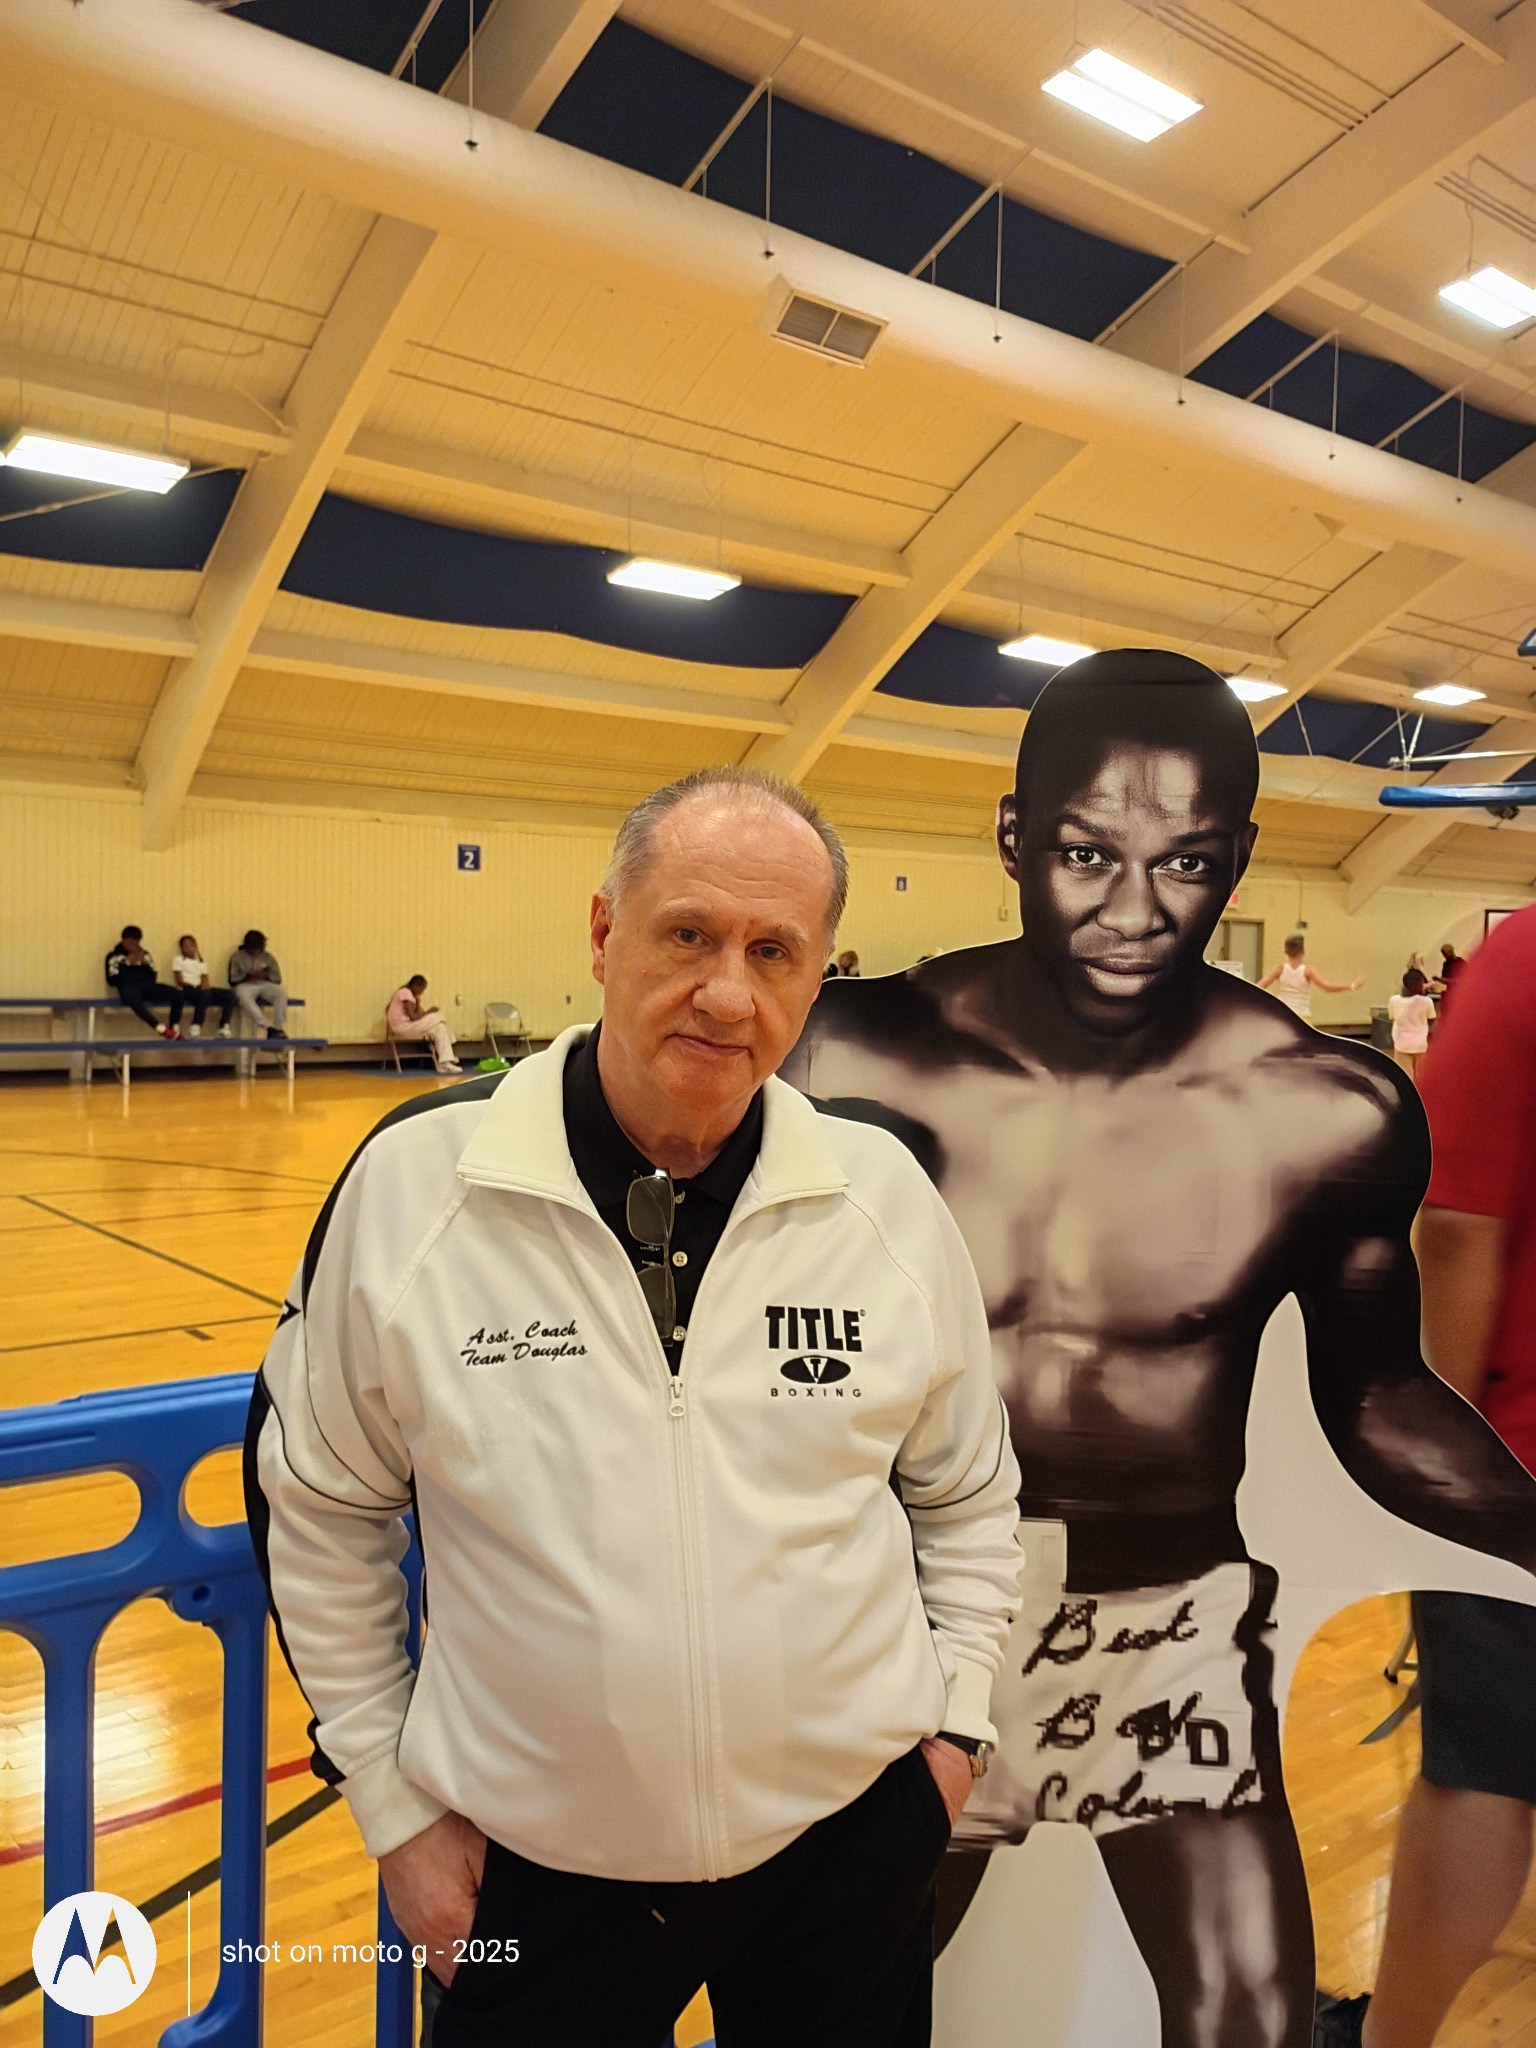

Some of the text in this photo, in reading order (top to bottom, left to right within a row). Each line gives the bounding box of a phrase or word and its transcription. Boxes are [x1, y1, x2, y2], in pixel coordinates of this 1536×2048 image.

[464, 851, 475, 869] 2
[466, 1319, 578, 1347] Asst. Coach
[764, 1305, 863, 1353] TITLE
[460, 1342, 587, 1367] Team Douglas
[770, 1387, 862, 1398] BOXING
